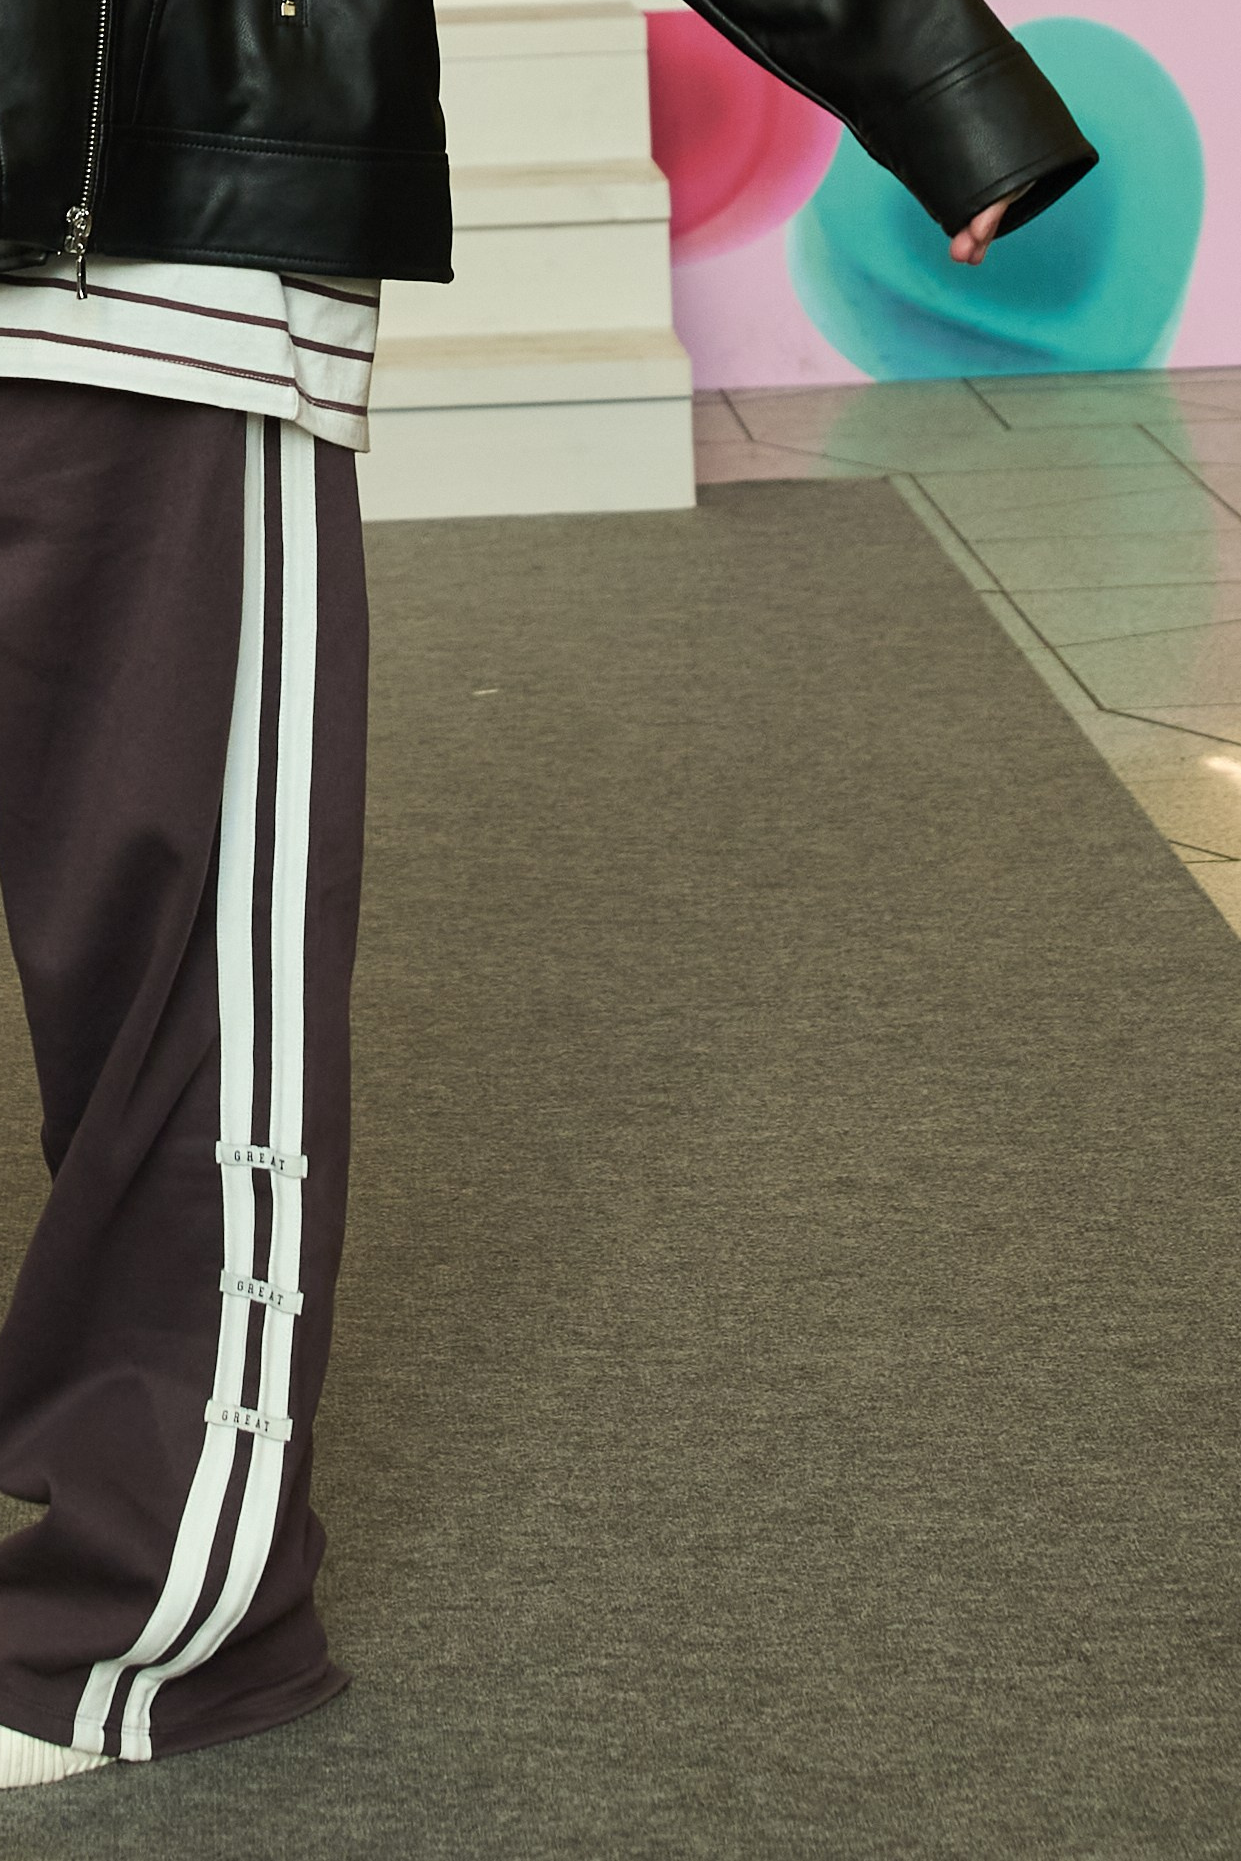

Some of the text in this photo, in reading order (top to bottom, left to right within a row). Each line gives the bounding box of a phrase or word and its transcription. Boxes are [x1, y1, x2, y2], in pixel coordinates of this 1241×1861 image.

[233, 1149, 286, 1172] GREAT
[236, 1279, 285, 1306] GREAT
[220, 1409, 272, 1433] GREAT
